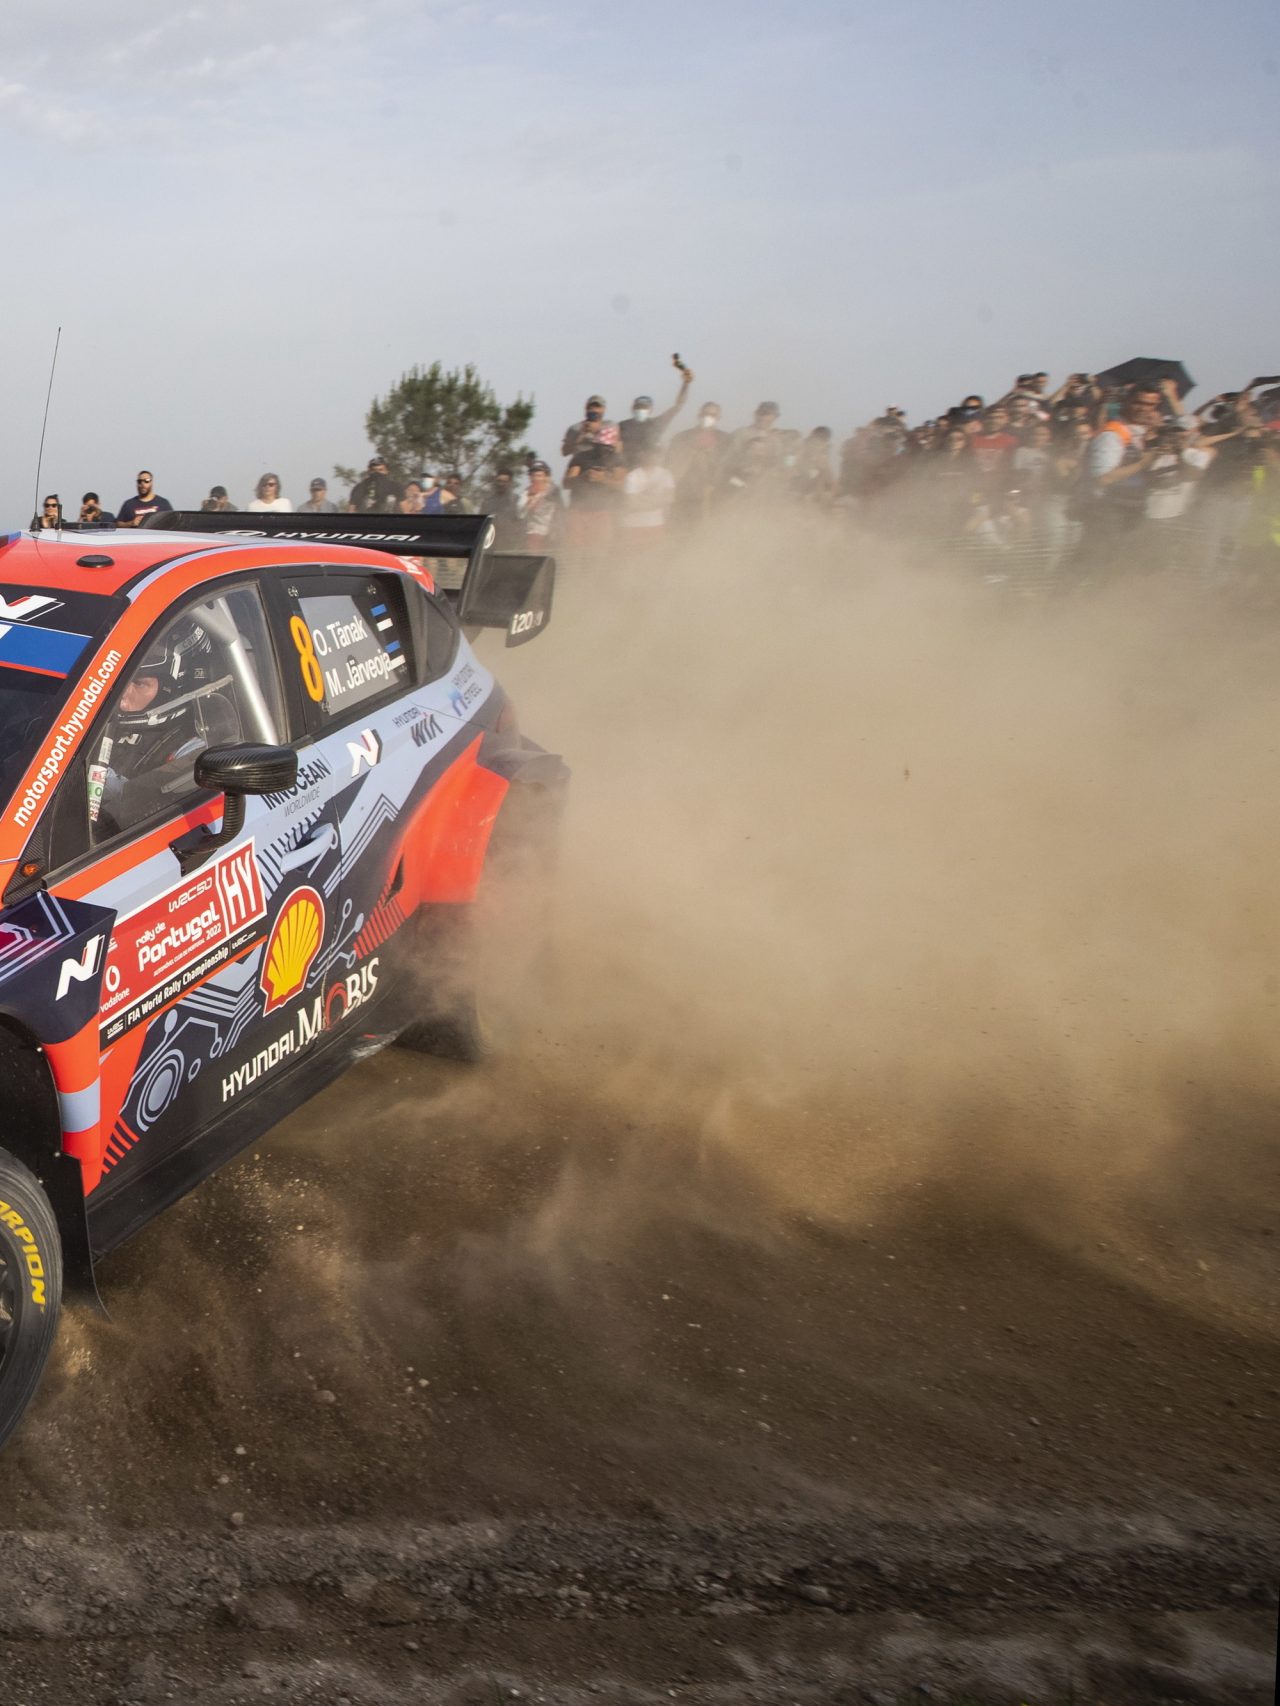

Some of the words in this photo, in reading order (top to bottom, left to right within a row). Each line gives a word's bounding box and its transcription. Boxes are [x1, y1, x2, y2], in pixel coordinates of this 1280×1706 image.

[273, 531, 421, 542] HYUNDAI
[313, 629, 332, 656] O.
[326, 615, 368, 649] Tänak
[290, 615, 325, 702] 8
[325, 668, 346, 698] M.
[346, 648, 393, 690] Järveoja
[13, 649, 122, 828] motorsport.hyundai.com
[392, 706, 421, 728] HYUNDAI
[284, 786, 321, 816] WORLDWIDE
[221, 850, 257, 926] HY
[135, 928, 156, 948] rally
[154, 921, 167, 934] de
[138, 901, 221, 972] Portugal
[205, 922, 222, 942] 2022
[100, 987, 131, 1013] vodafone
[127, 1010, 141, 1026] FIA
[141, 990, 163, 1014] World
[163, 979, 182, 1000] Rally
[182, 945, 229, 986] Championship
[222, 1029, 295, 1102] HYUNDAI
[295, 957, 380, 1053] MOBIS
